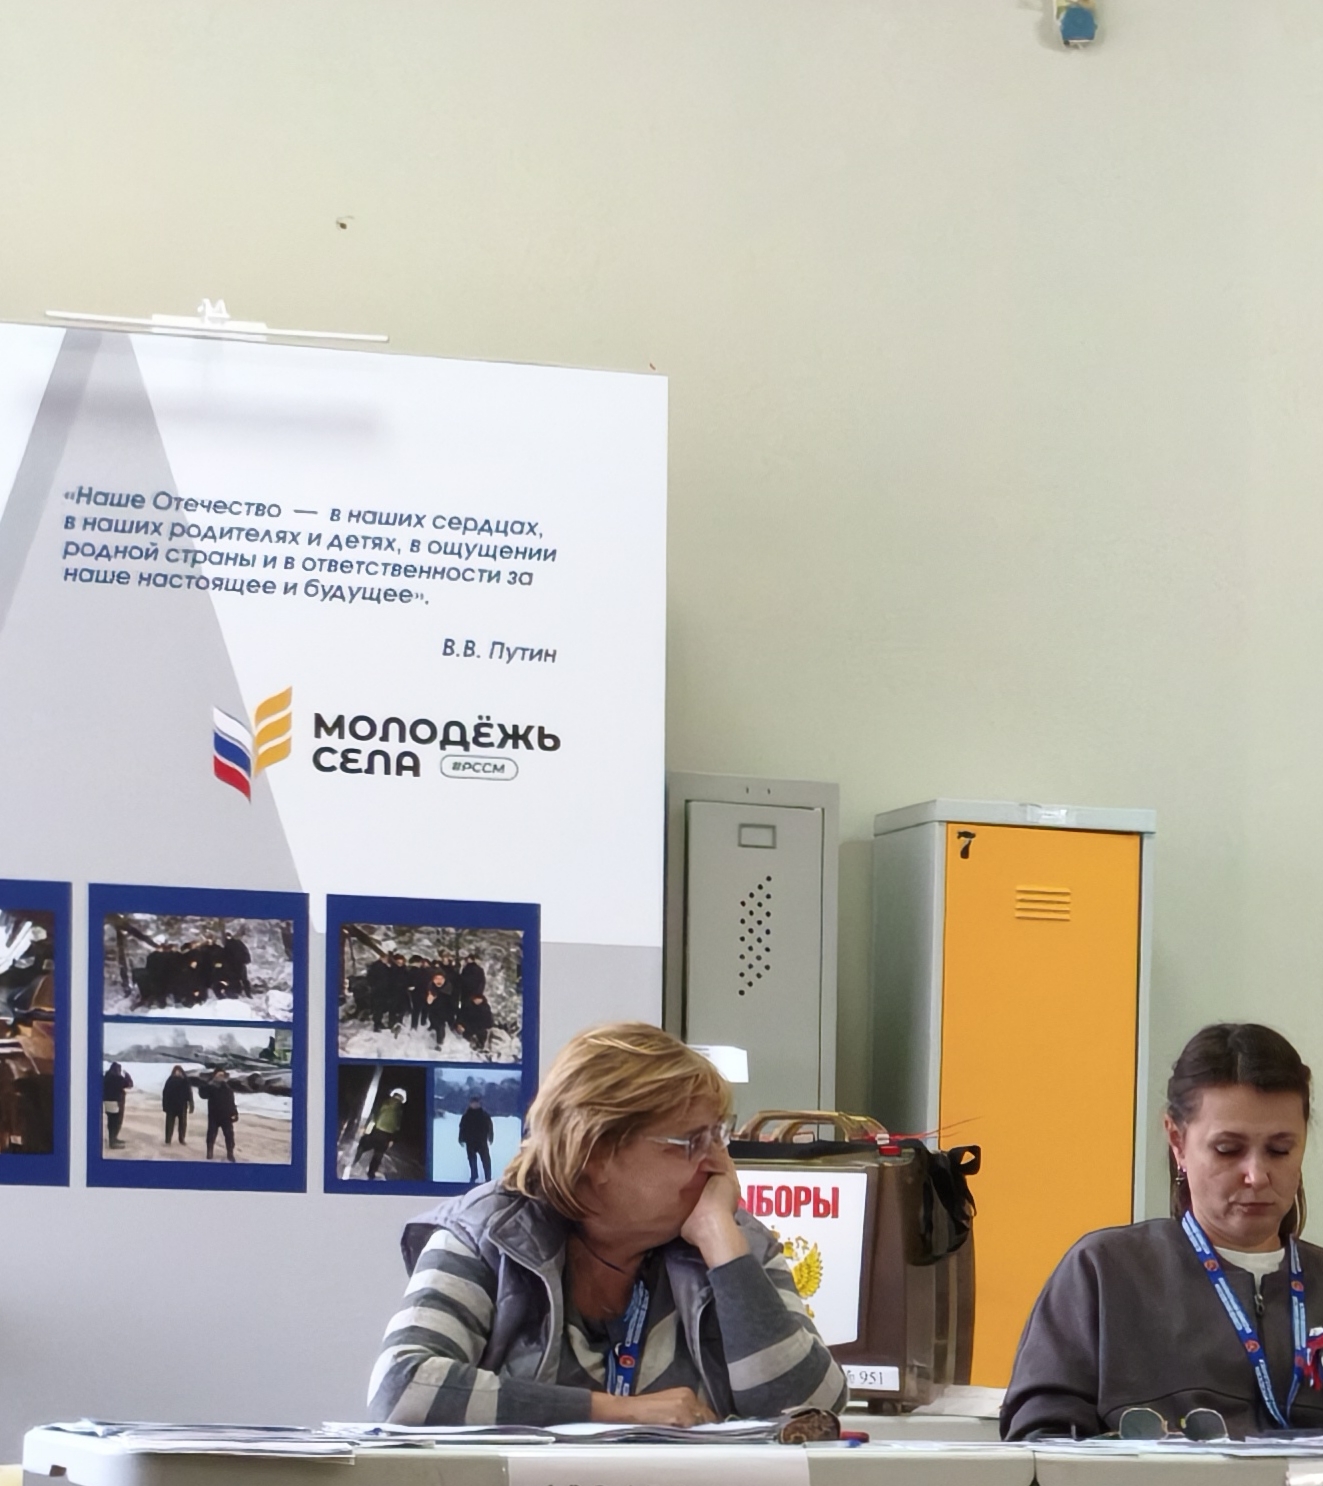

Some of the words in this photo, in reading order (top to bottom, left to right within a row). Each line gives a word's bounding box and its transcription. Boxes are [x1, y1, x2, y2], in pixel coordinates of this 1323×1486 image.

[64, 486, 146, 509] «Наше
[152, 491, 281, 518] Отечество
[329, 508, 341, 522] в
[348, 509, 427, 529] наших
[432, 514, 544, 539] сердцах,
[64, 515, 76, 530] в
[82, 517, 163, 536] наших
[168, 521, 302, 546] родителях
[307, 532, 322, 547] и
[327, 533, 401, 555] детях,
[410, 539, 421, 553] в
[427, 539, 557, 562] ощущении
[62, 541, 159, 561] родной
[165, 547, 257, 568] страны
[262, 554, 277, 569] и
[284, 556, 295, 570] в
[301, 557, 501, 584] ответственности
[506, 571, 534, 586] за
[63, 567, 131, 585] наше
[138, 571, 277, 595] настоящее
[283, 582, 298, 596] и
[303, 579, 429, 605] будущее».
[442, 638, 481, 659] В.В.
[488, 640, 557, 664] Путин
[312, 712, 561, 752] МОЛОДЁЖЬ
[311, 748, 421, 778] СЕЛА
[957, 831, 976, 859] 7
